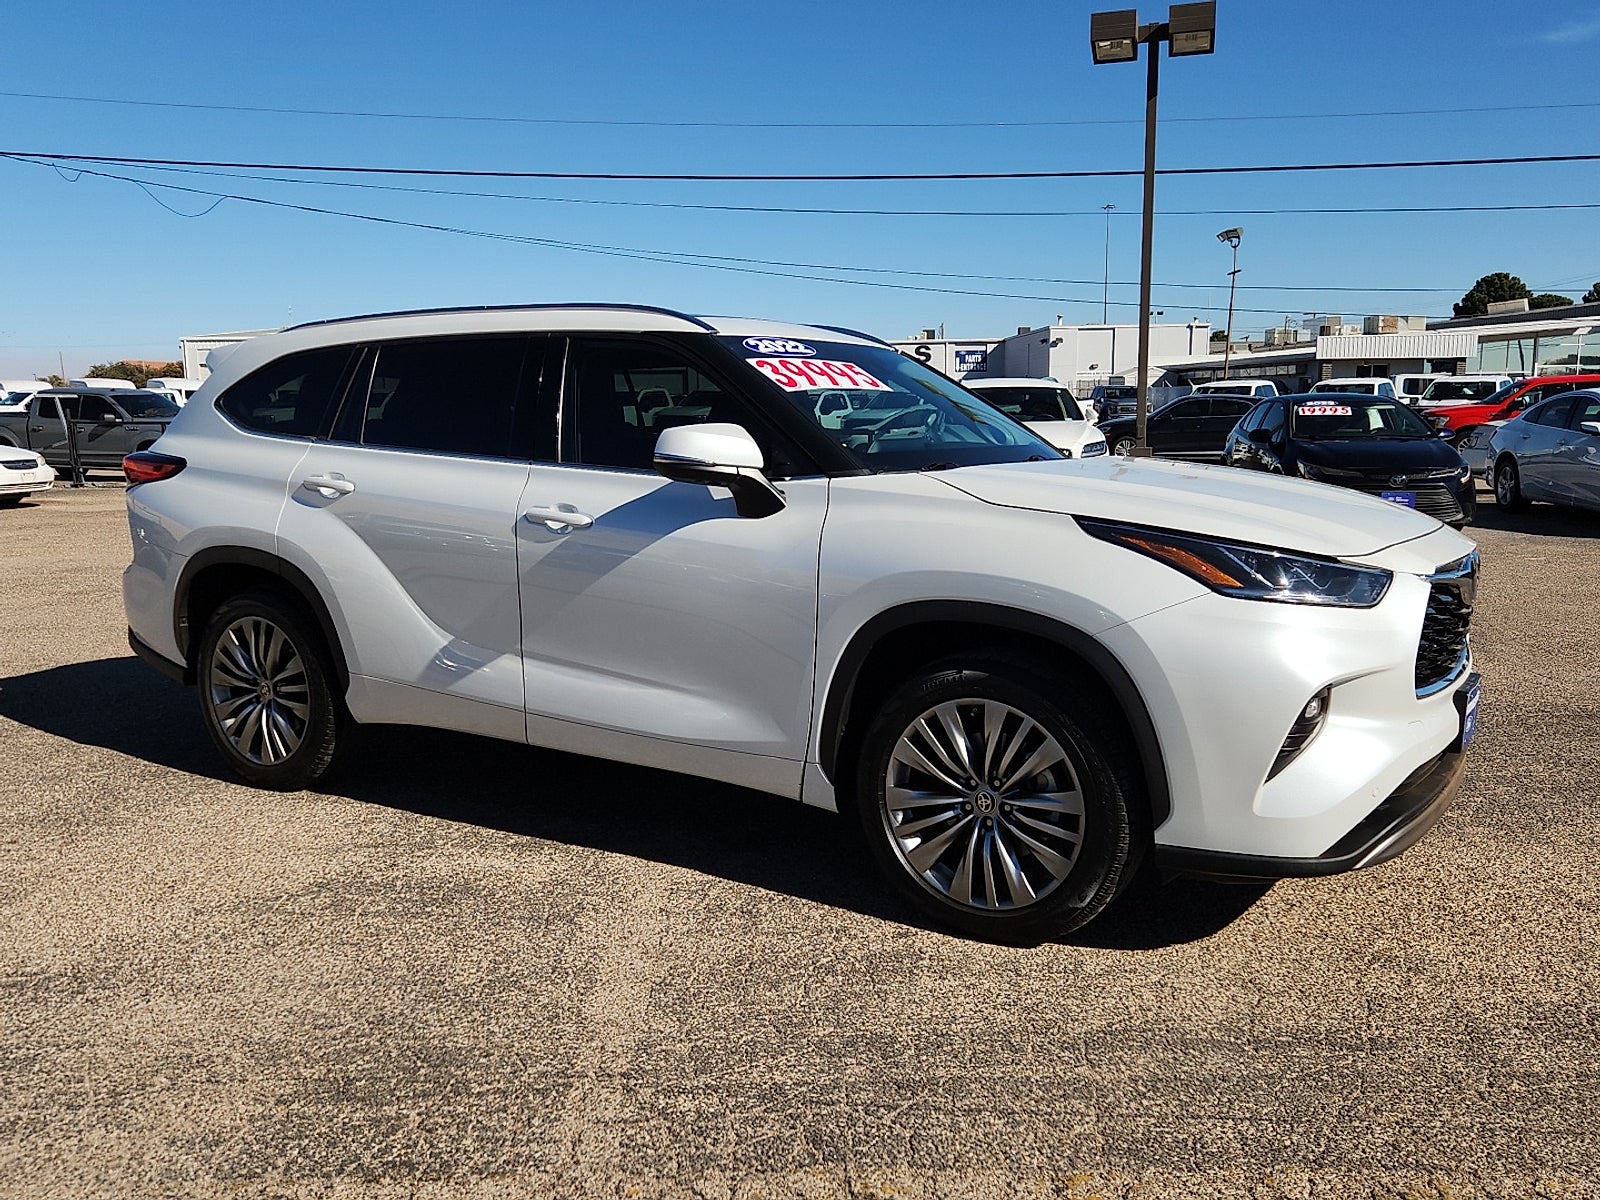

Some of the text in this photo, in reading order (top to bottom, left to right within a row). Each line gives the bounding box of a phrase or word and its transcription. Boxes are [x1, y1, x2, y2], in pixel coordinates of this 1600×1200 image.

[748, 339, 814, 353] 2022
[965, 354, 982, 363] PARTS
[960, 363, 987, 371] ENTRANCE
[755, 359, 880, 388] 39995
[1300, 406, 1349, 415] 19995
